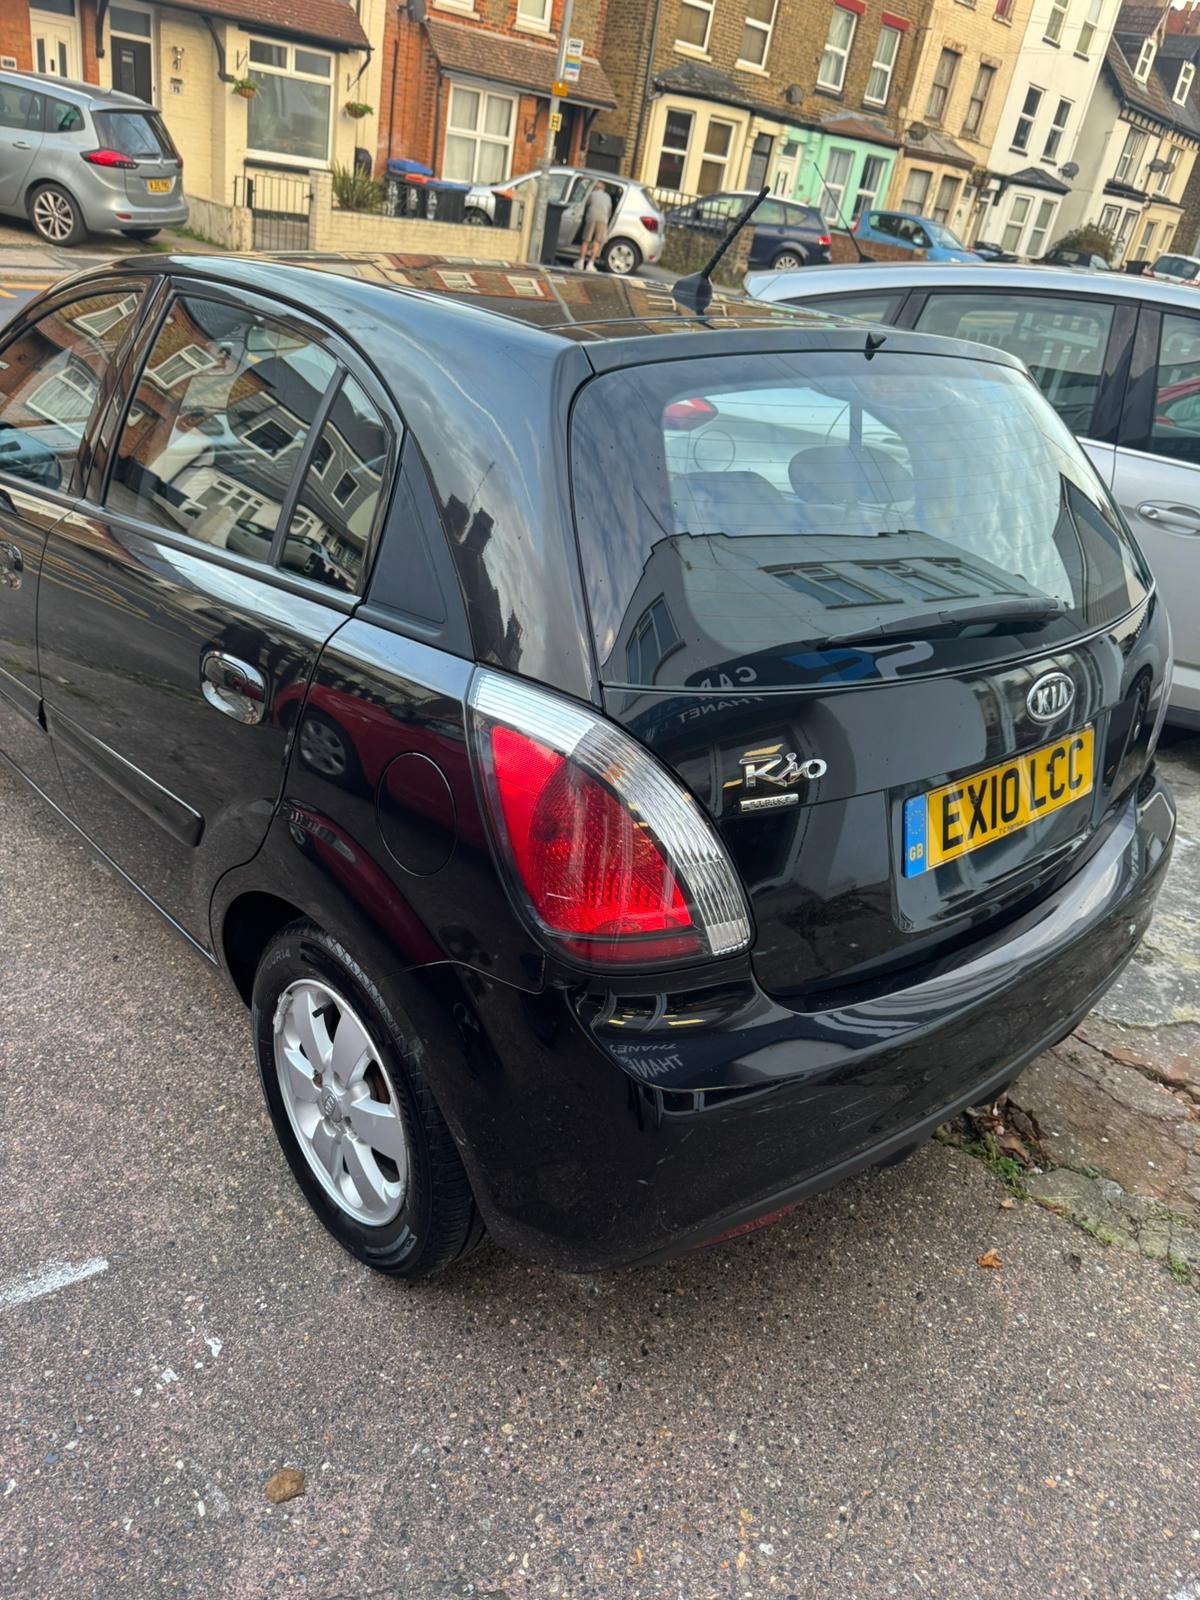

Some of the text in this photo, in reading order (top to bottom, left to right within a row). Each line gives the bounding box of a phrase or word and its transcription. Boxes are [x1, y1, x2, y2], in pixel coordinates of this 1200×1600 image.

[1036, 680, 1069, 714] KIA
[739, 752, 827, 788] Rio
[942, 738, 1084, 852] EX10 LCC
[909, 843, 924, 861] GB
